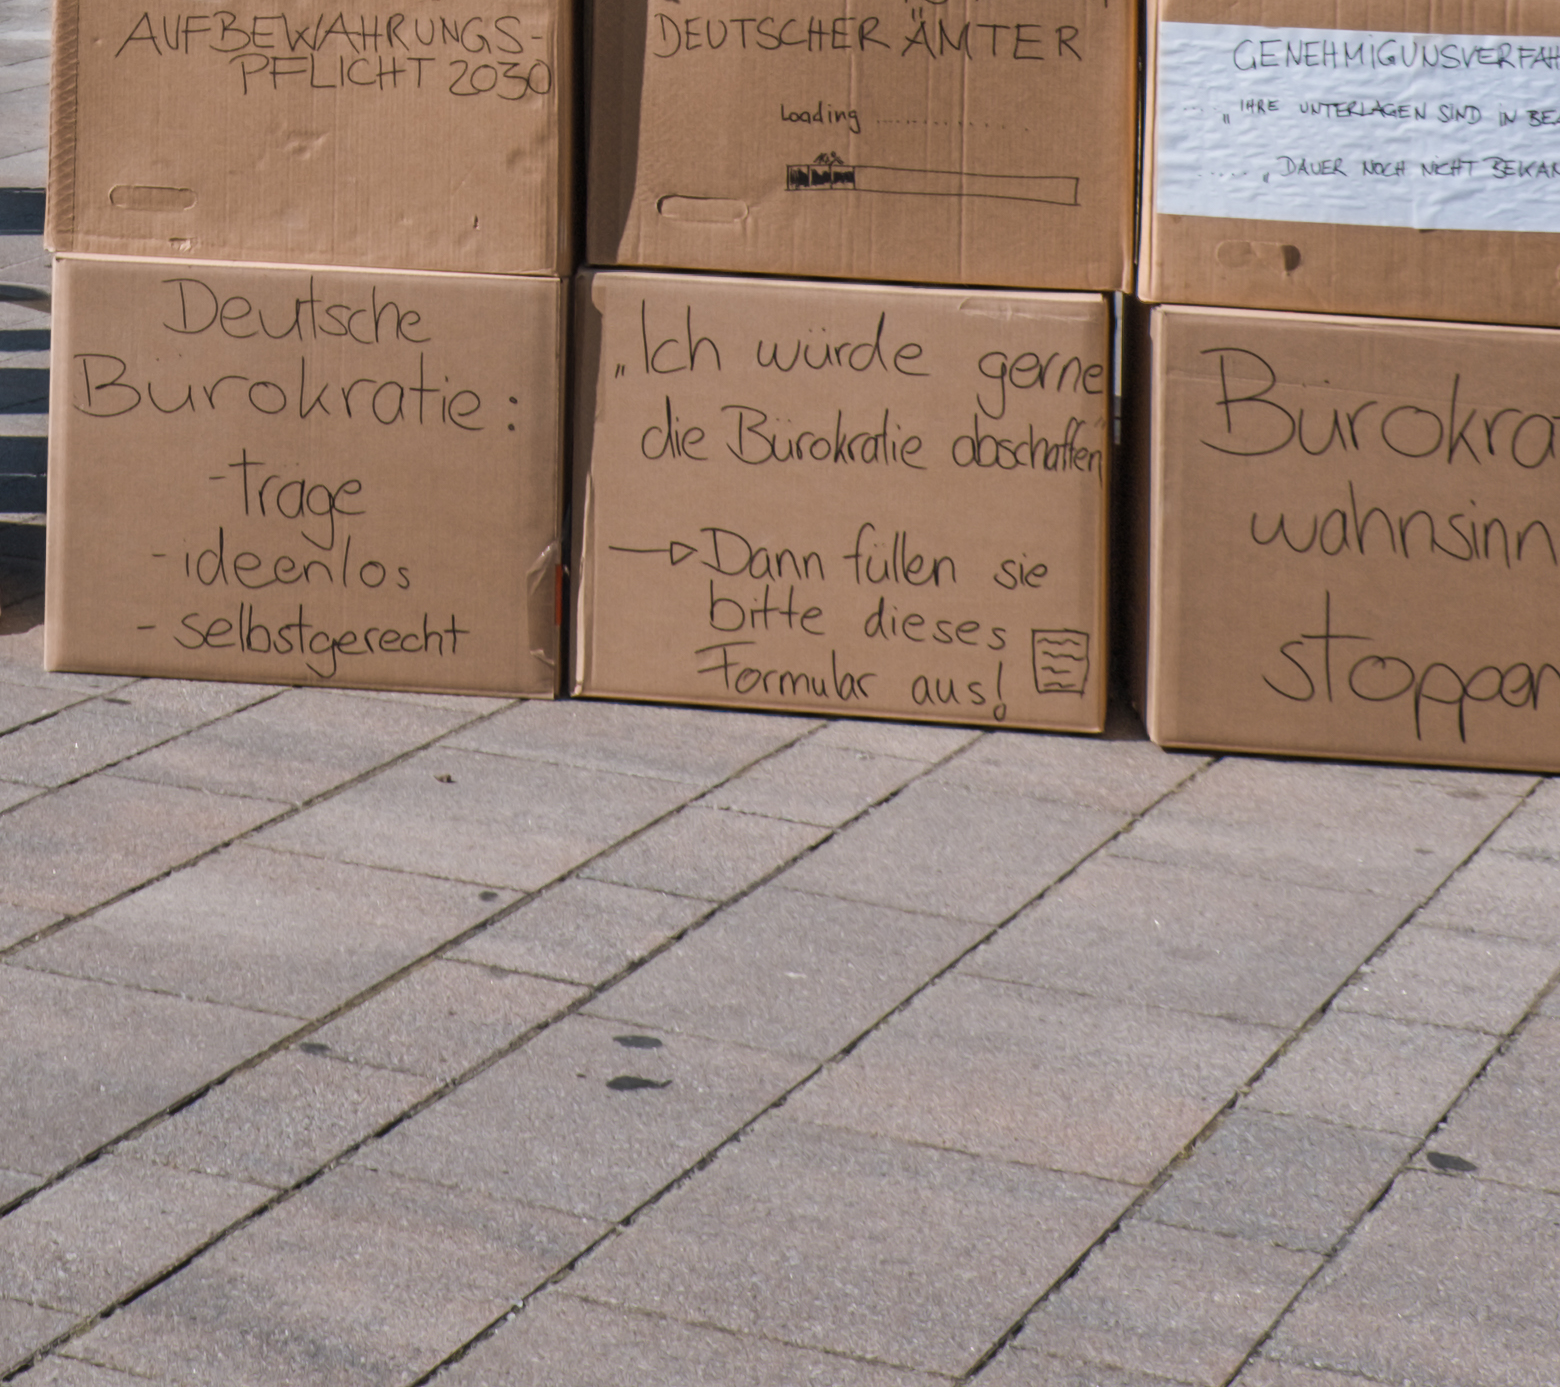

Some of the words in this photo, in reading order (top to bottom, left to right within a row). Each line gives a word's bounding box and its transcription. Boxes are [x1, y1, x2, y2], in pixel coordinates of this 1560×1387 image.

[115, 11, 543, 58] AUFBEWAHRUNGS-
[653, 13, 892, 58] DEUTSCHER
[901, 6, 1082, 61] ÄMTER
[229, 53, 435, 96] PFLICHT
[447, 59, 554, 100] 2030
[1299, 101, 1428, 122] UNTERLAGEN
[1436, 101, 1482, 125] SIND
[1498, 107, 1518, 125] IN
[1361, 159, 1407, 178] NOCH
[1421, 155, 1479, 178] NICHT
[162, 274, 433, 345] Deutsche
[756, 310, 932, 377] würde
[976, 350, 1105, 420] gerne
[641, 395, 709, 462] die
[720, 404, 928, 471] Bürokratie
[700, 527, 825, 583] Dann
[842, 522, 958, 587] füllen
[993, 552, 1050, 591] sie
[1250, 479, 1559, 570] wahnsinn
[709, 578, 826, 637] bitte
[864, 596, 1008, 652] dieses
[694, 640, 878, 701] Formular
[910, 660, 1008, 722] aus!
